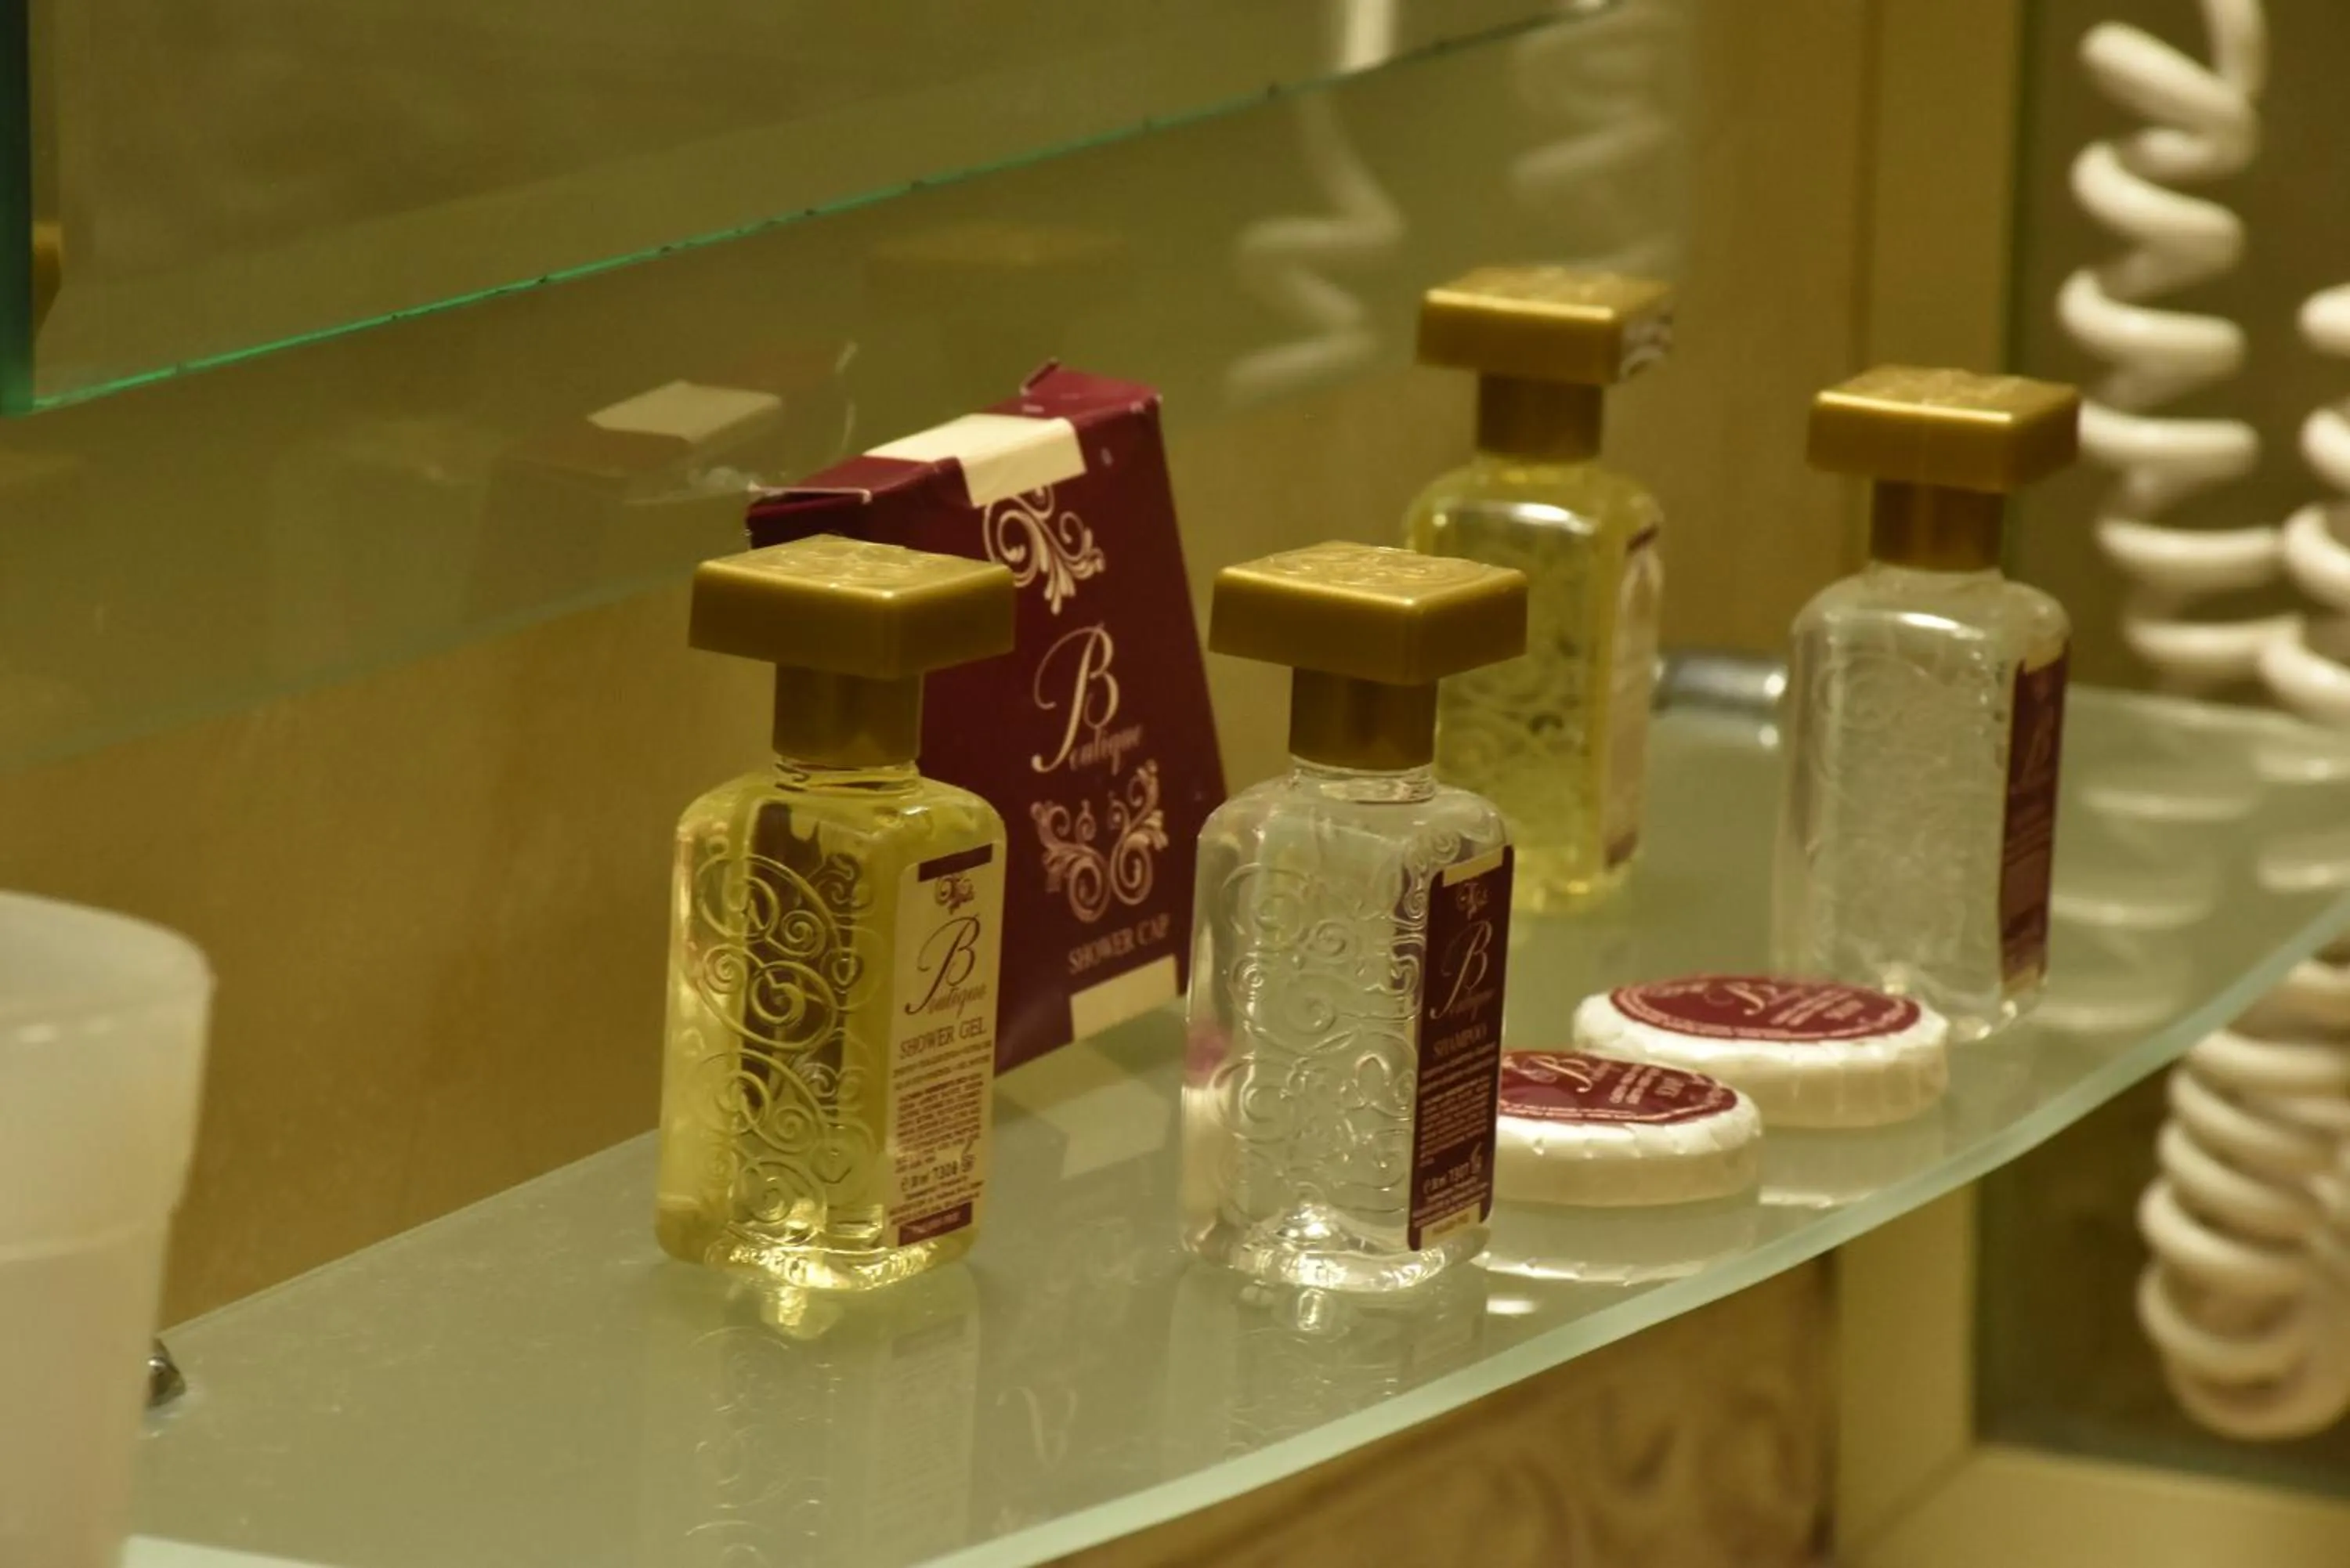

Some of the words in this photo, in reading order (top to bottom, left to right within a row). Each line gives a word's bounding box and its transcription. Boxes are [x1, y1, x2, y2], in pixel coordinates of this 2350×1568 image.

[1068, 927, 1135, 974] SHOWER
[900, 1025, 955, 1060] SHOWER
[959, 1017, 987, 1039] GEL
